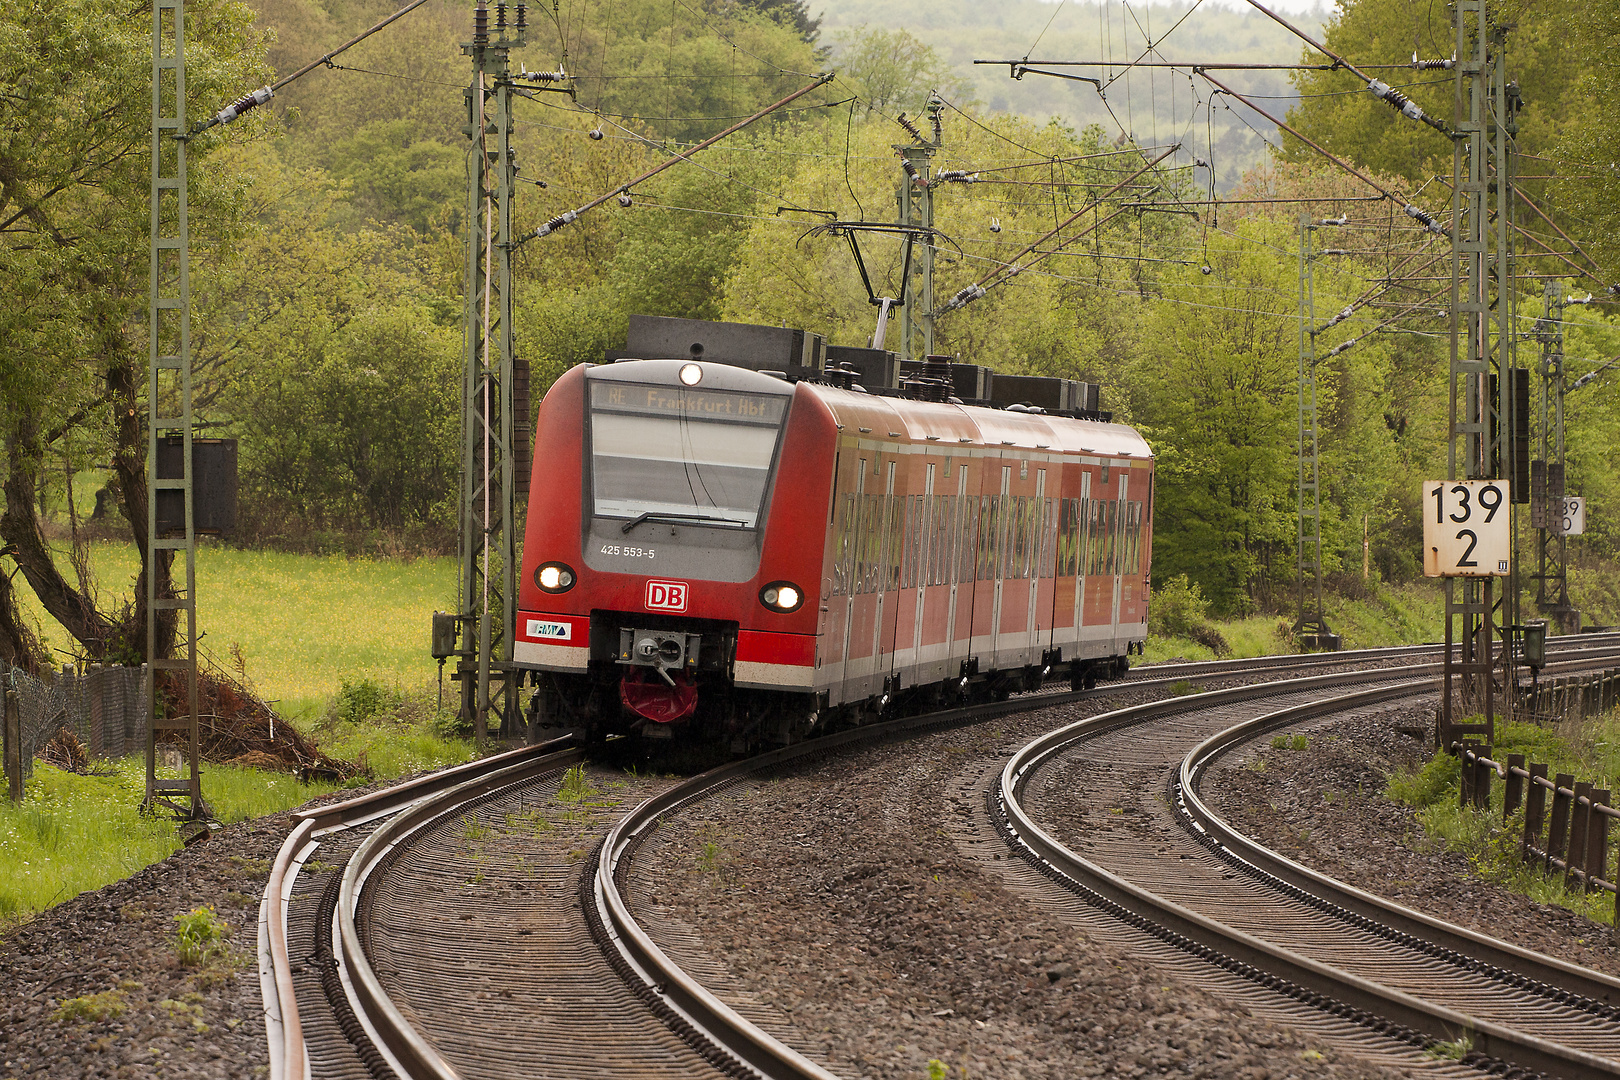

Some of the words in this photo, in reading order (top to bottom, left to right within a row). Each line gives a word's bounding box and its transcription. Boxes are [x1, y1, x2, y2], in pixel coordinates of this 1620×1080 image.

[608, 387, 627, 405] RE
[647, 390, 733, 414] Frankfurt
[738, 397, 766, 417] Hbf
[1431, 485, 1503, 524] 139
[600, 544, 620, 556] 425
[623, 547, 655, 559] 553-5
[1455, 529, 1478, 568] 2
[650, 585, 683, 607] DB
